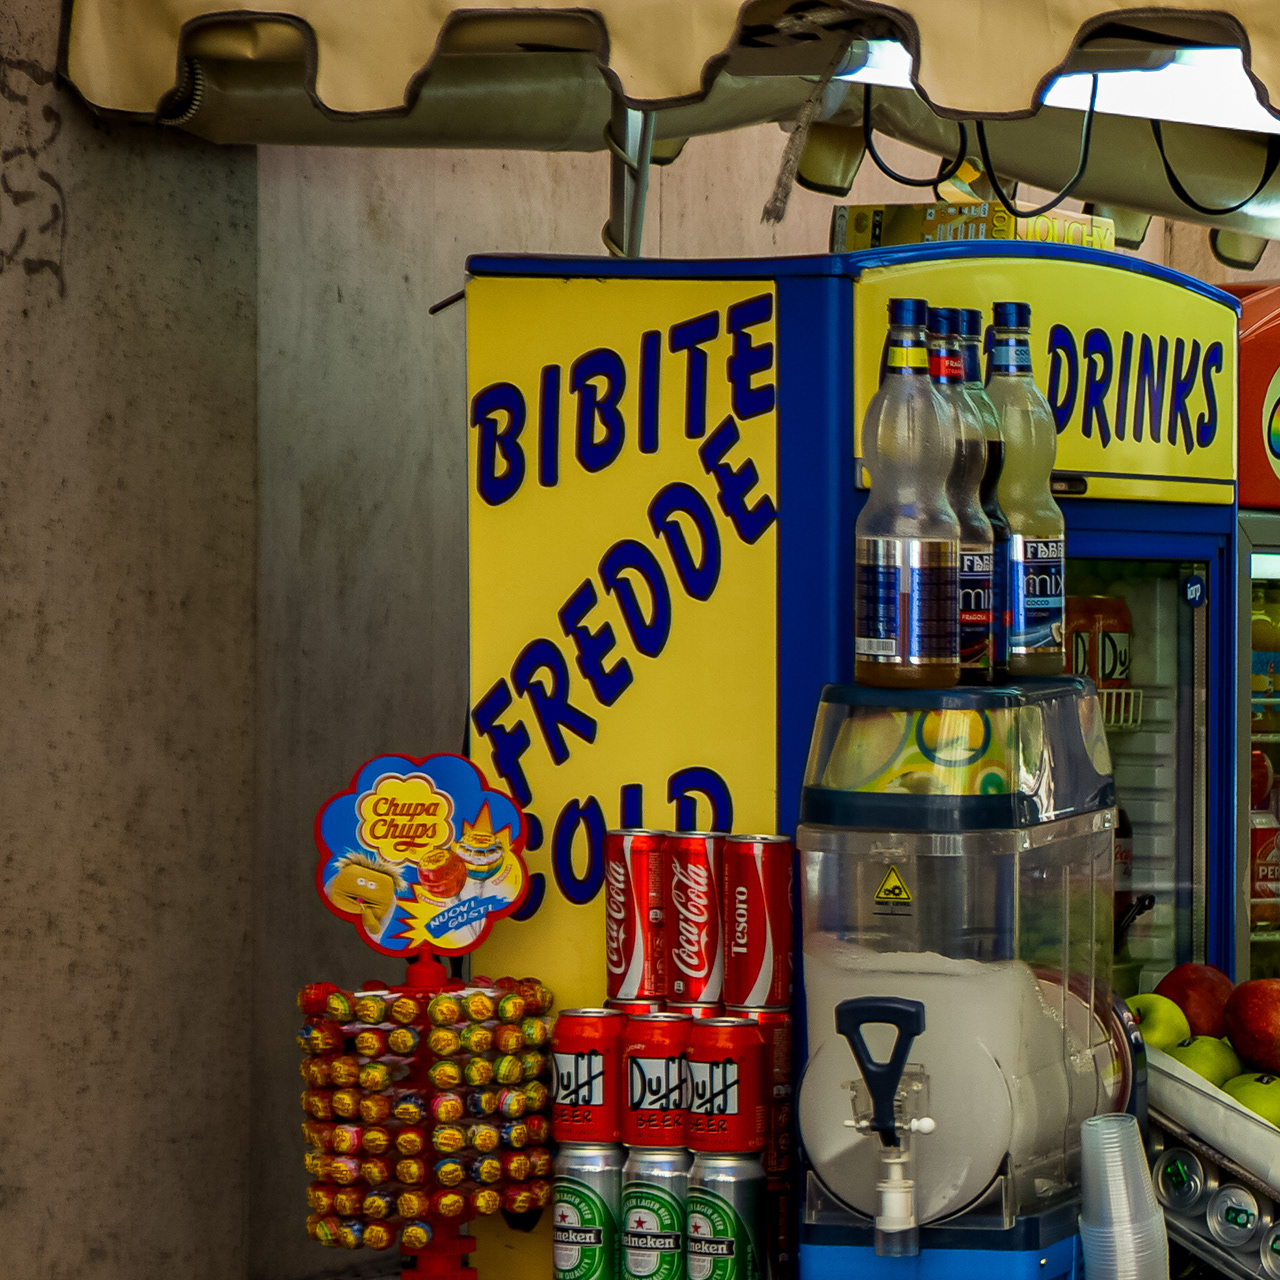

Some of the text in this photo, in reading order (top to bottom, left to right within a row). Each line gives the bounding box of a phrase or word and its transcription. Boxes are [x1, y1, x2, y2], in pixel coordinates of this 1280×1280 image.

[470, 291, 776, 506] BIBITE
[1047, 323, 1224, 455] DRINKS
[471, 415, 777, 808] FREDDE
[372, 797, 441, 823] Chupa
[369, 819, 438, 842] Chups
[429, 899, 476, 929] NUOVI
[448, 904, 495, 929] GUSTI
[731, 886, 749, 958] Tesoro
[637, 1113, 683, 1130] BEER
[561, 1193, 593, 1220] LAGER BEER
[637, 1199, 672, 1226] LAGER BEER
[711, 1212, 725, 1231] BEER
[553, 1228, 596, 1244] ineken
[622, 1234, 675, 1249] eineken
[689, 1241, 728, 1255] neken
[564, 1258, 592, 1280] QUALITY
